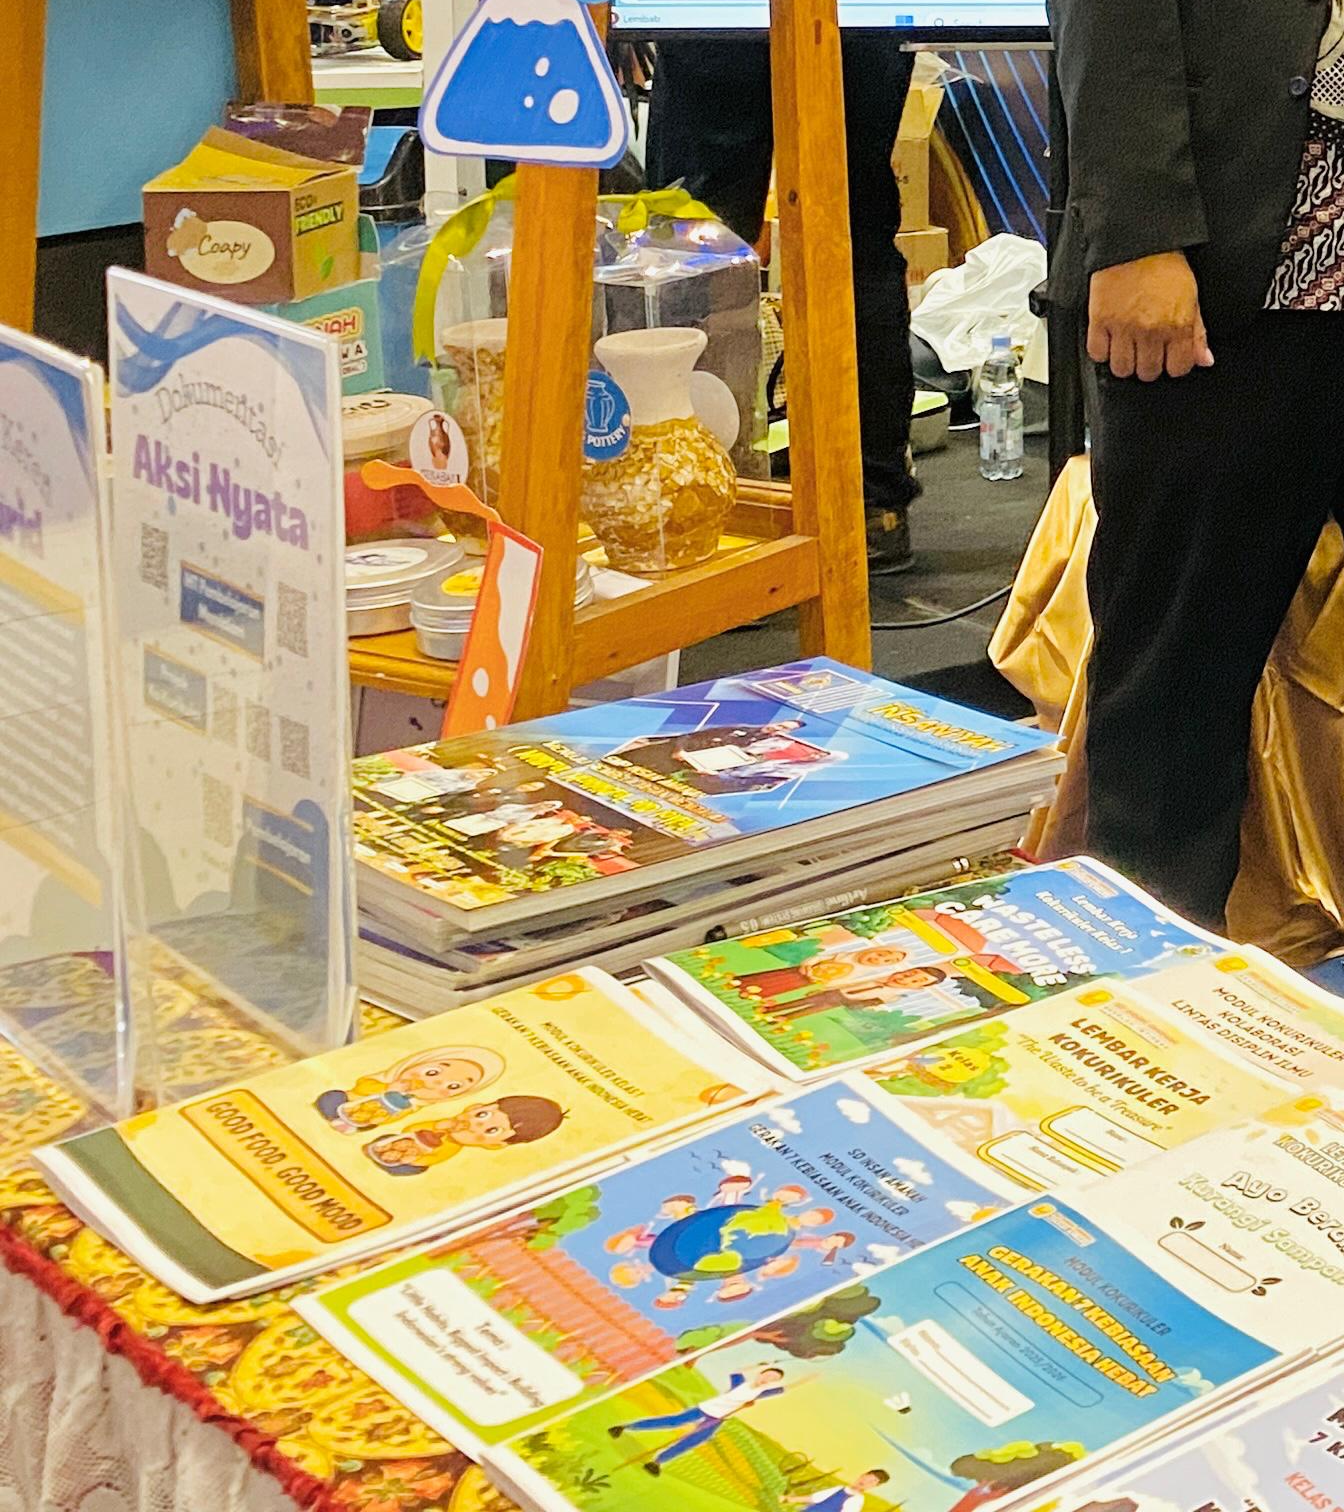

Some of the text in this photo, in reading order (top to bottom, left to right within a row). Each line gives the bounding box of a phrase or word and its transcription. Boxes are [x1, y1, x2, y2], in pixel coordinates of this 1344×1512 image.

[155, 373, 286, 468] Dokumentasi
[587, 424, 626, 448] POTTERY
[133, 434, 200, 504] Aksi
[207, 462, 309, 551] Nyata
[934, 900, 1068, 987] CARE MORE
[972, 894, 1097, 975] WASTE LESS
[1171, 999, 1221, 1031] LINTAS
[1216, 1028, 1279, 1066] DISIPLIN
[1275, 1059, 1314, 1079] ILMU
[1213, 986, 1259, 1016] MODUL
[1218, 1010, 1306, 1057] KOLABORASI
[949, 1049, 980, 1073] Kelas
[1039, 1051, 1078, 1082] Waste
[1074, 1076, 1089, 1088] to
[1085, 1081, 1103, 1099] be
[1048, 1033, 1180, 1116] KOKURIKULER
[1070, 1018, 1150, 1069] LEMBAR
[1144, 1066, 1211, 1105] KERJA
[206, 1101, 363, 1231] GOOD FOOD, GOOD MOOD
[748, 1123, 794, 1158] GERAKAN
[790, 1158, 844, 1199] KEBIASAAN
[837, 1194, 868, 1216] ANAK
[818, 1152, 851, 1178] MODUL
[1178, 1172, 1271, 1233] Kurangi
[1221, 1170, 1288, 1203] Ayo
[957, 1253, 1159, 1398] ANAK INDONESIA HEBAT
[987, 1245, 1079, 1305] GERAKAN
[1081, 1303, 1177, 1383] KEBIASAAN
[1284, 1471, 1333, 1511] KELAS
